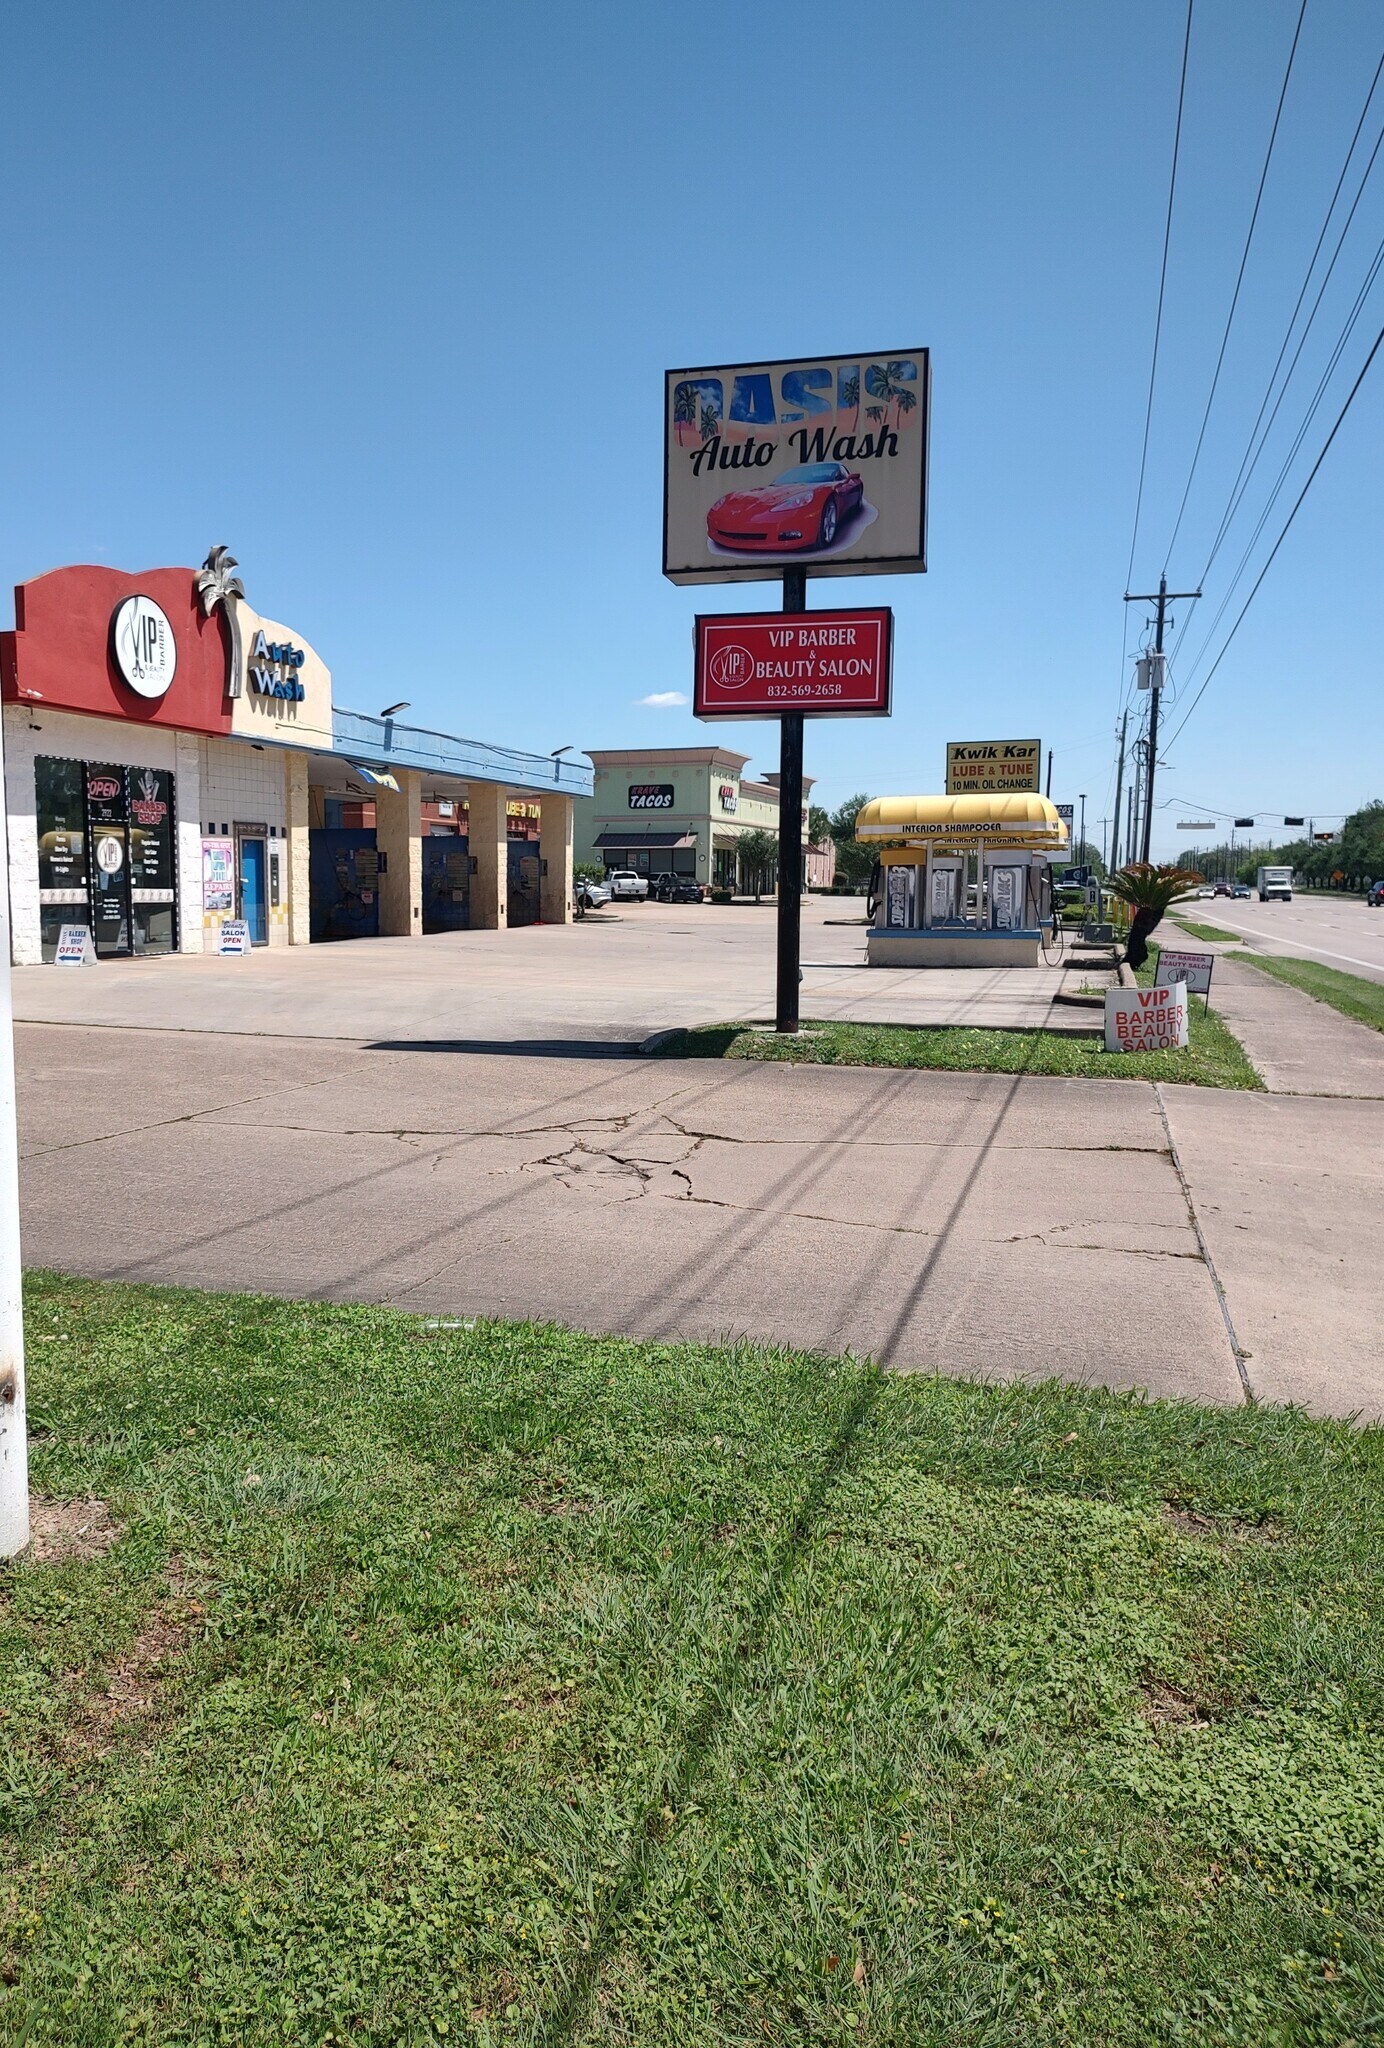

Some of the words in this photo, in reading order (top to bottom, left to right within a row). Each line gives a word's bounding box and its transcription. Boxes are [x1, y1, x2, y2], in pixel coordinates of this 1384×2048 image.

[674, 361, 918, 447] OASIS
[690, 435, 778, 477] Auto
[788, 424, 899, 464] Wash
[129, 612, 157, 668] VIP
[769, 630, 795, 648] VIP
[799, 628, 856, 647] BARBER
[253, 629, 305, 668] Auto
[809, 650, 817, 659] &
[720, 653, 740, 678] VIP
[756, 660, 815, 679] BEAUTY
[818, 658, 873, 677] SALON
[249, 667, 305, 702] Wash
[767, 683, 842, 697] 832-569-2658
[951, 746, 998, 760] Kwik
[1002, 745, 1036, 758] Kar
[953, 765, 985, 777] LUBE
[988, 766, 996, 775] &
[1000, 763, 1033, 776] TUNE
[89, 780, 117, 798] OPEN
[631, 785, 660, 795] KRAVE
[952, 781, 962, 791] 10
[963, 780, 980, 790] MIN.
[982, 779, 995, 790] OIL
[997, 778, 1033, 788] CHANGE
[132, 800, 167, 815] BARBER
[630, 794, 672, 808] TACOS
[137, 811, 162, 825] SHOP
[902, 824, 943, 833] INTERIOR
[945, 823, 1002, 832] SHAMPOOER
[59, 946, 84, 954] OPEN
[1160, 960, 1187, 968] BEAUTY
[1188, 962, 1210, 970] SALON
[1178, 955, 1206, 963] BARBER
[1137, 989, 1170, 1008] VIP
[1115, 1005, 1184, 1025] BARBER
[1117, 1019, 1183, 1039] BEAUTY
[1122, 1033, 1180, 1052] SALON
